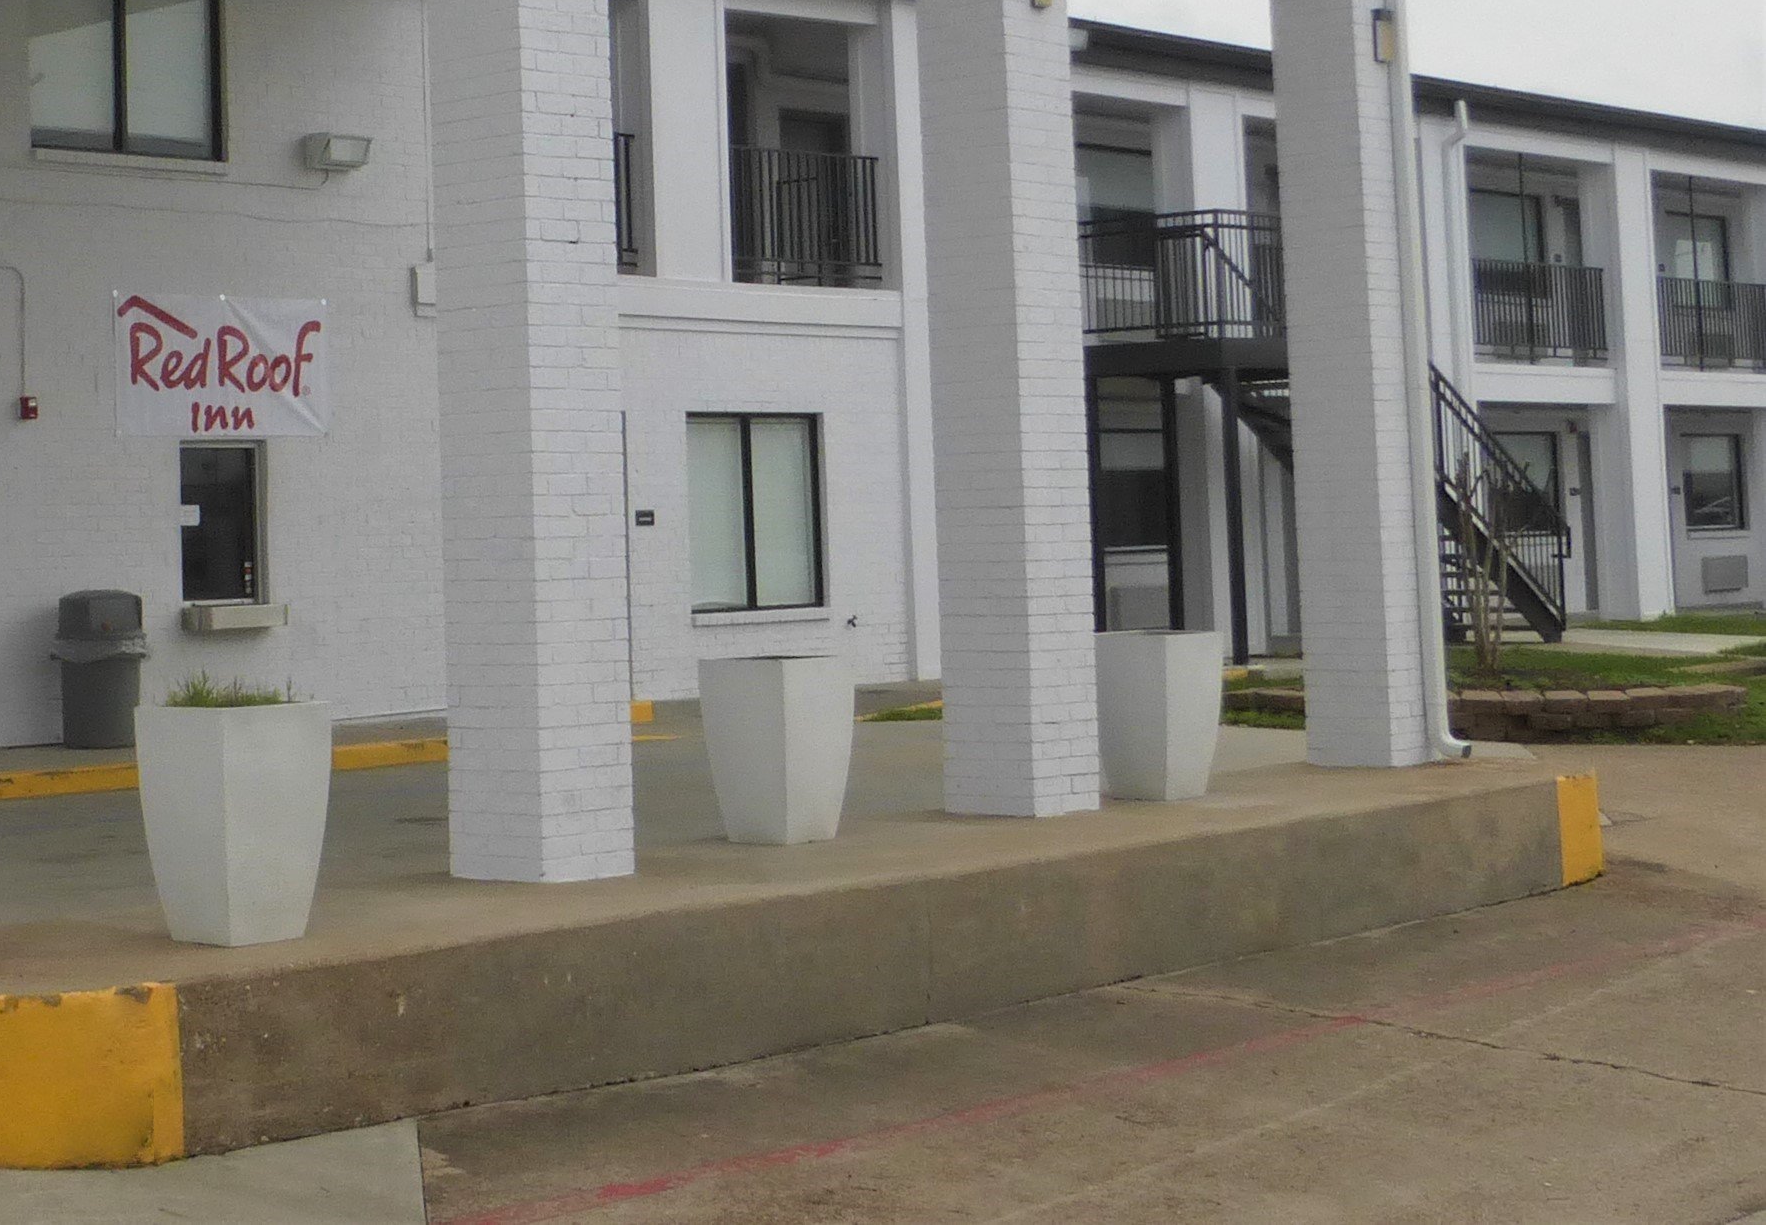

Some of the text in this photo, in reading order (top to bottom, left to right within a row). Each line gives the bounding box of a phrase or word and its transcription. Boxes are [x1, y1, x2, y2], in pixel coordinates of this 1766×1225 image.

[129, 320, 322, 398] Red Roof
[191, 400, 256, 434] Inn
